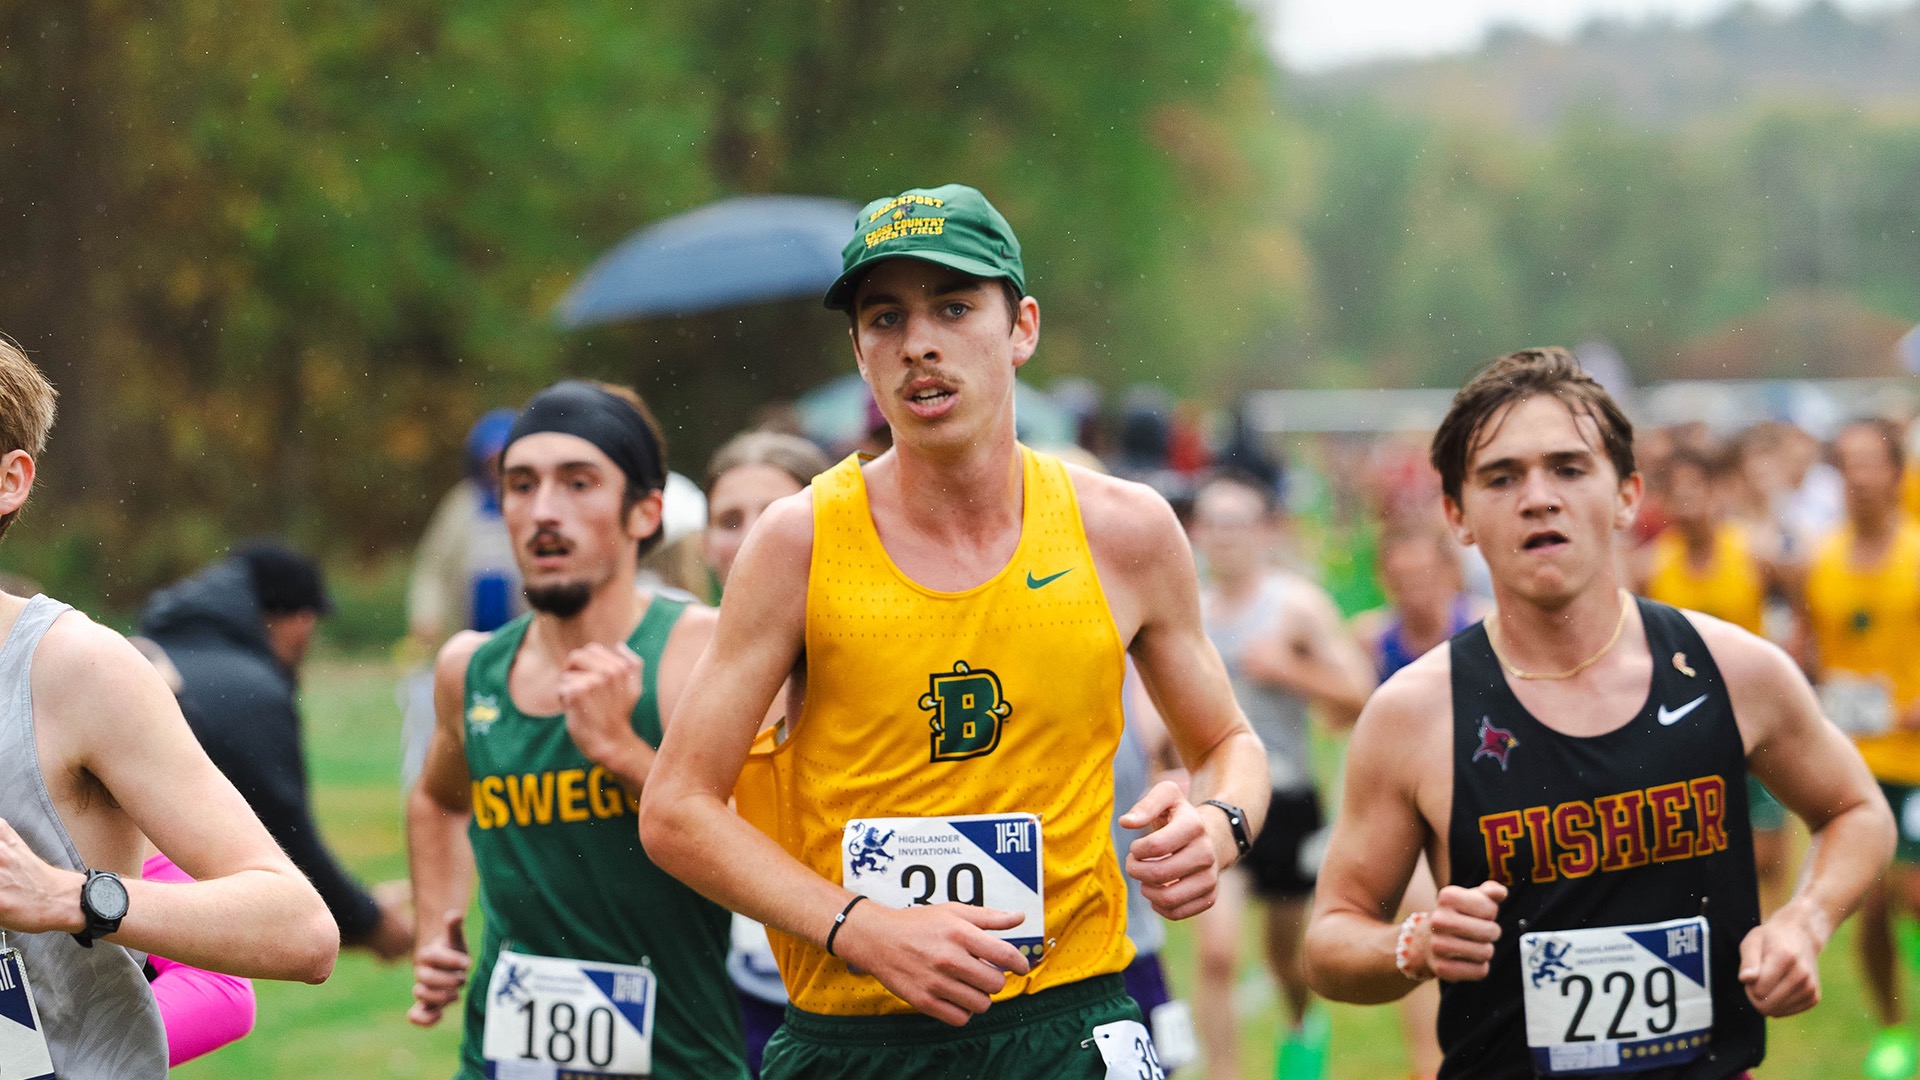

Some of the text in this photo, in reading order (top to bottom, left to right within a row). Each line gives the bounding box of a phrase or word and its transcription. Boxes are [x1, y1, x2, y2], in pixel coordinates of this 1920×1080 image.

[865, 217, 945, 242] CROSS COUNTRY
[910, 227, 943, 235] FIELD
[929, 668, 1004, 763] B
[898, 834, 960, 844] HIGHLANDER
[898, 847, 962, 856] INVITATIONAL
[1479, 774, 1728, 885] FISHER
[1560, 966, 1677, 1043] 229
[518, 999, 614, 1067] 180
